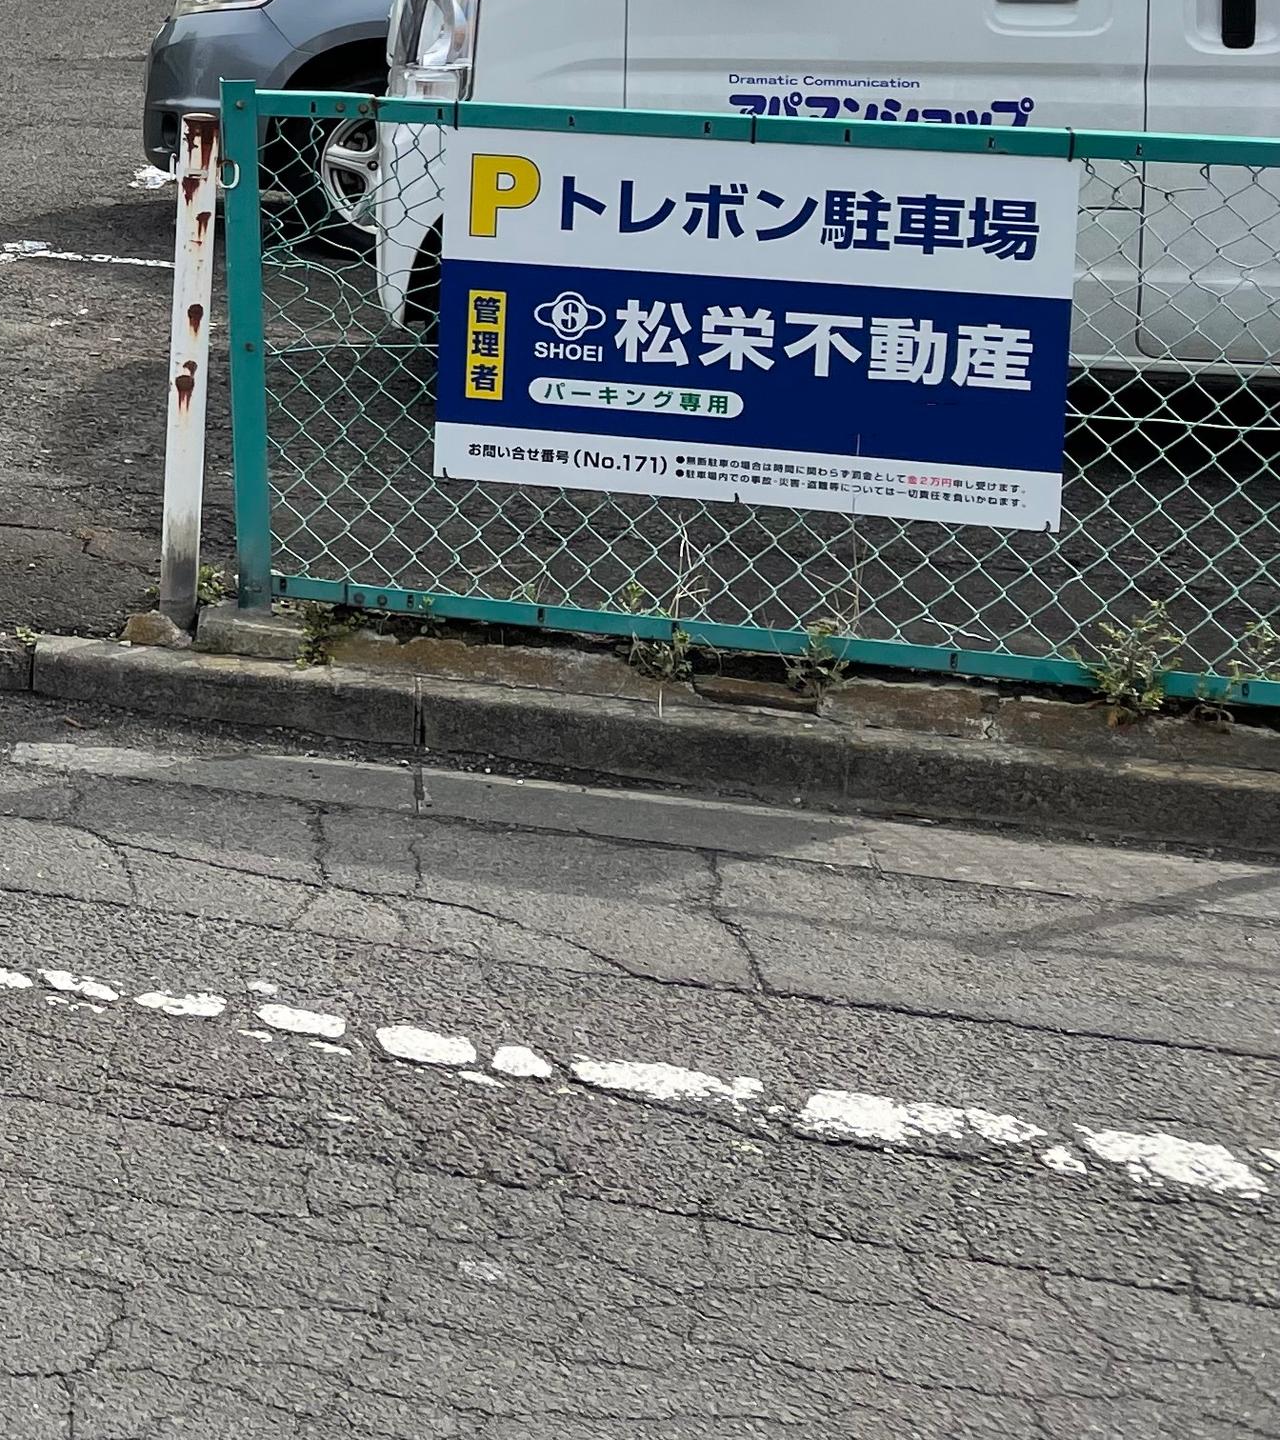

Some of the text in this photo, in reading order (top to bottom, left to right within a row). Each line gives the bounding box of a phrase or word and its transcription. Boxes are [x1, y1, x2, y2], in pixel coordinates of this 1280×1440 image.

[728, 73, 921, 89] Dramatic Communication
[468, 153, 1041, 261] P トレボン駐車場
[470, 296, 501, 393] 管理者
[534, 340, 604, 362] SHOEI
[614, 296, 1035, 392] 松栄不動産
[543, 381, 730, 416] パーキング専用
